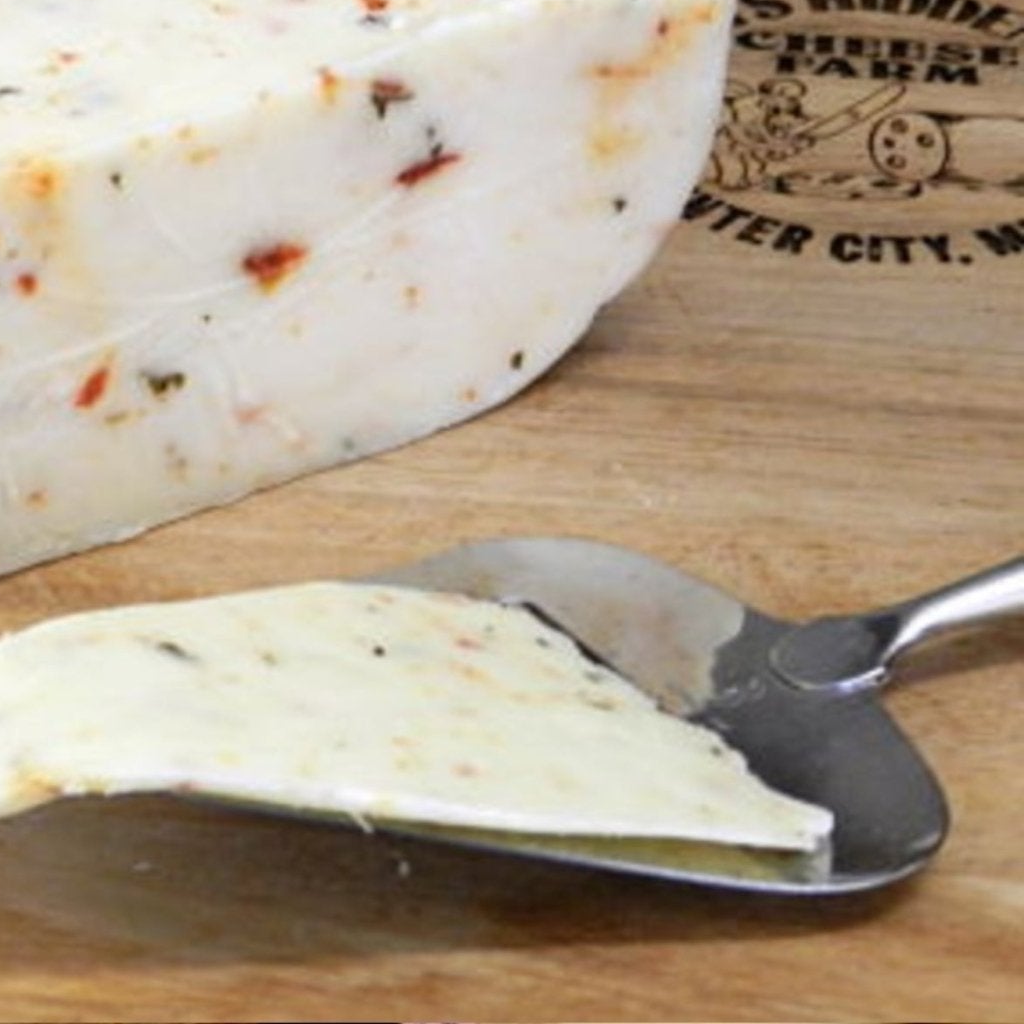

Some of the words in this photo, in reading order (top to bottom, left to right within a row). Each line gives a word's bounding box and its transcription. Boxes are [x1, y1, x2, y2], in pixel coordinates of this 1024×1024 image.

[734, 30, 1019, 68] CHEESE
[776, 55, 980, 86] FARM
[679, 185, 814, 255] NTER
